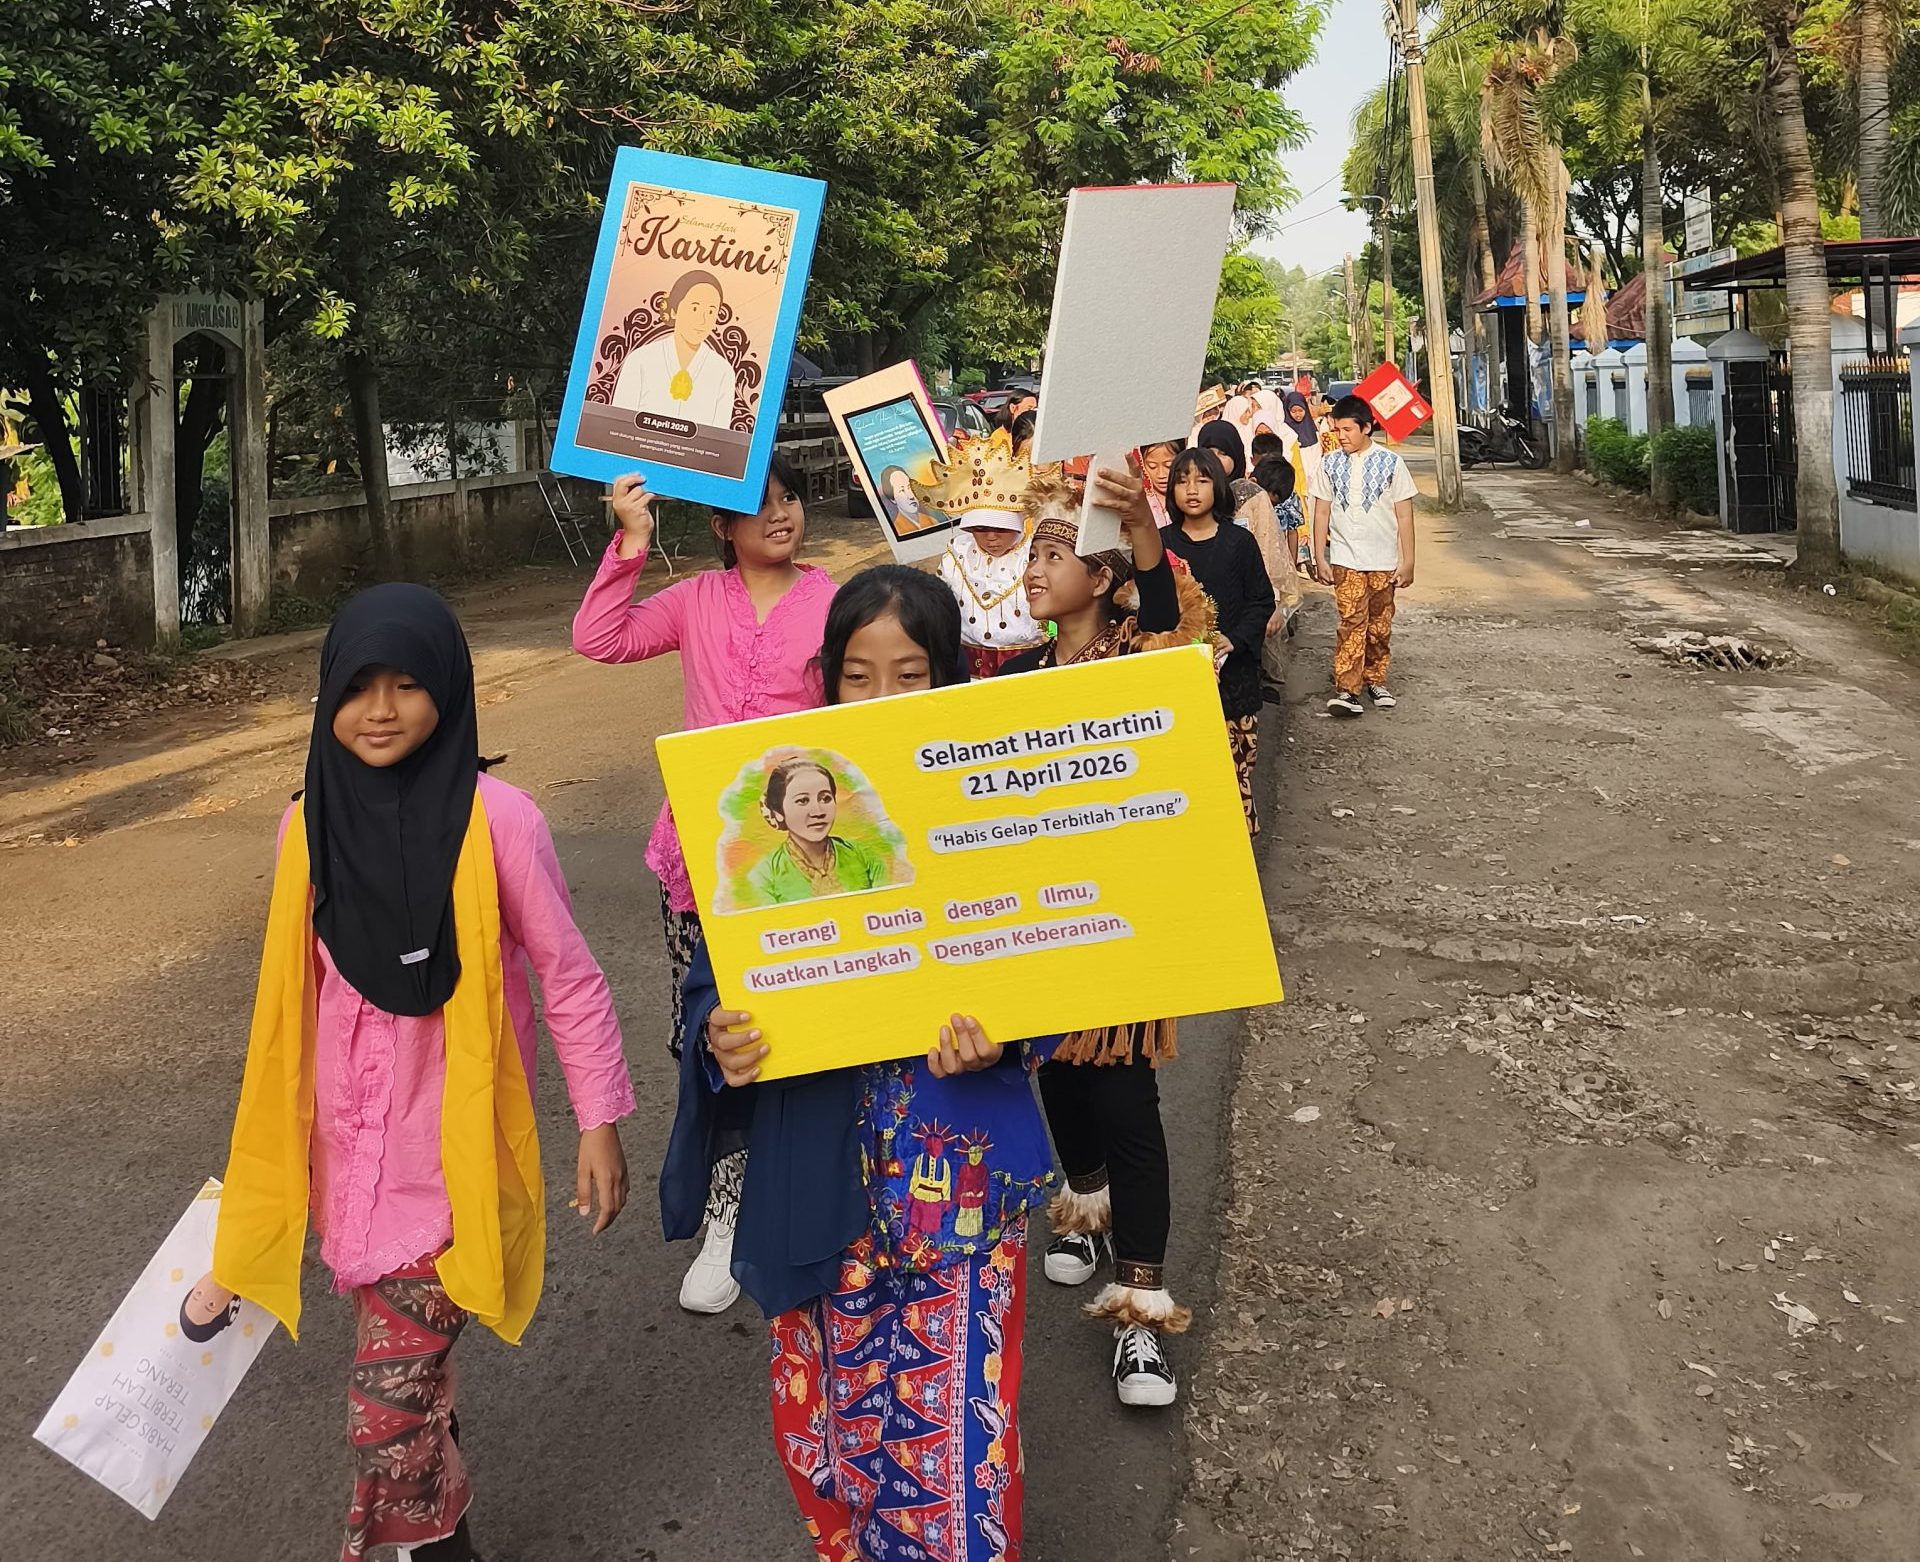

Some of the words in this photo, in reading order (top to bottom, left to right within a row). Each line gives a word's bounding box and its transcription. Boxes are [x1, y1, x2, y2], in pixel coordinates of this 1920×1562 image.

[633, 215, 777, 275] Kartini
[679, 214, 715, 229] Selamat
[715, 221, 737, 233] Hari
[651, 418, 670, 431] April
[921, 735, 1019, 768] Selamat
[1024, 724, 1075, 750] Hari
[1082, 710, 1163, 741] Kartini
[968, 774, 998, 795] 21
[1005, 762, 1062, 792] April
[1068, 753, 1127, 780] 2026
[934, 828, 988, 848] “Habis
[991, 821, 1038, 840] Gelap
[1041, 809, 1115, 832] Terbitlah
[1118, 797, 1182, 820] Terang”
[765, 921, 837, 949] Terangi
[867, 908, 923, 931] Dunia
[947, 894, 1018, 921] dengan
[1044, 886, 1094, 905] Ilmu,
[751, 964, 829, 989] Kuatkan
[834, 948, 912, 976] Langkah
[934, 937, 1007, 961] Dengan
[1012, 916, 1127, 947] Keberanian.
[137, 1358, 189, 1406] TERANG
[94, 1394, 140, 1430] GELAP
[139, 1420, 176, 1456] HABIS
